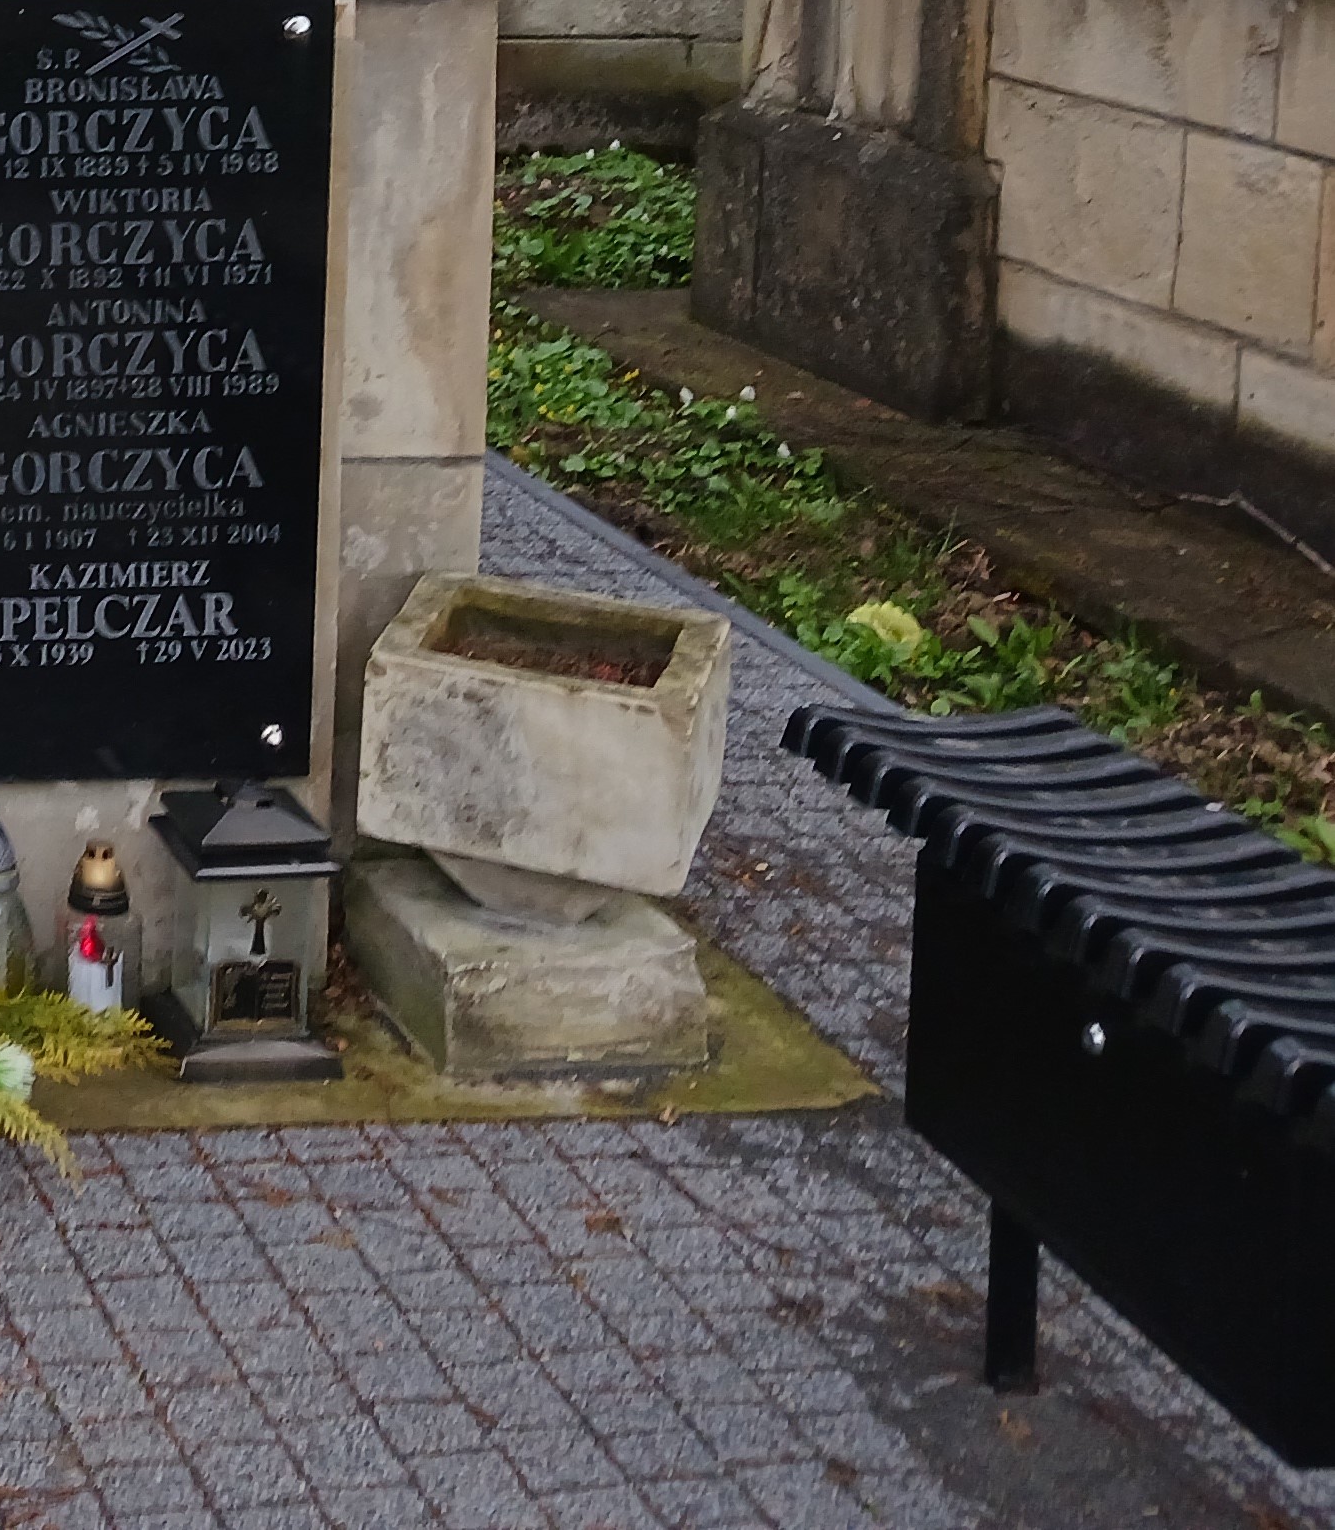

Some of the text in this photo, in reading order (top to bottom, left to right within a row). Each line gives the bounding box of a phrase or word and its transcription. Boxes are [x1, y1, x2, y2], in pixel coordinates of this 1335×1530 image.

[24, 74, 225, 104] BRONISŁAWA
[4, 157, 30, 179] 12
[40, 156, 66, 179] IX
[156, 153, 174, 176] 5
[182, 153, 210, 175] IV
[219, 151, 280, 175] 1968
[48, 187, 212, 214] WIKTORIA
[40, 267, 57, 290] X
[67, 266, 123, 289] 1892
[183, 265, 209, 286] VI
[222, 263, 273, 286] 1971
[46, 298, 208, 327] ANTONINA
[33, 379, 59, 401] IV
[66, 377, 119, 400] 1897
[131, 376, 162, 398] 28
[169, 375, 211, 397] VIII
[222, 373, 280, 396] 1989
[27, 408, 213, 438] AGNIESZKA
[0, 491, 247, 525] em. nauczycielka
[45, 527, 98, 550] 1907
[181, 524, 219, 546] XII
[227, 522, 281, 544] 2004
[28, 559, 211, 591] KAZIMIERZ
[0, 591, 239, 642] PELCZAR
[10, 643, 30, 666] X
[39, 641, 95, 665] 1939
[154, 639, 182, 663] 29
[190, 639, 208, 661] V
[215, 637, 271, 661] 2023
